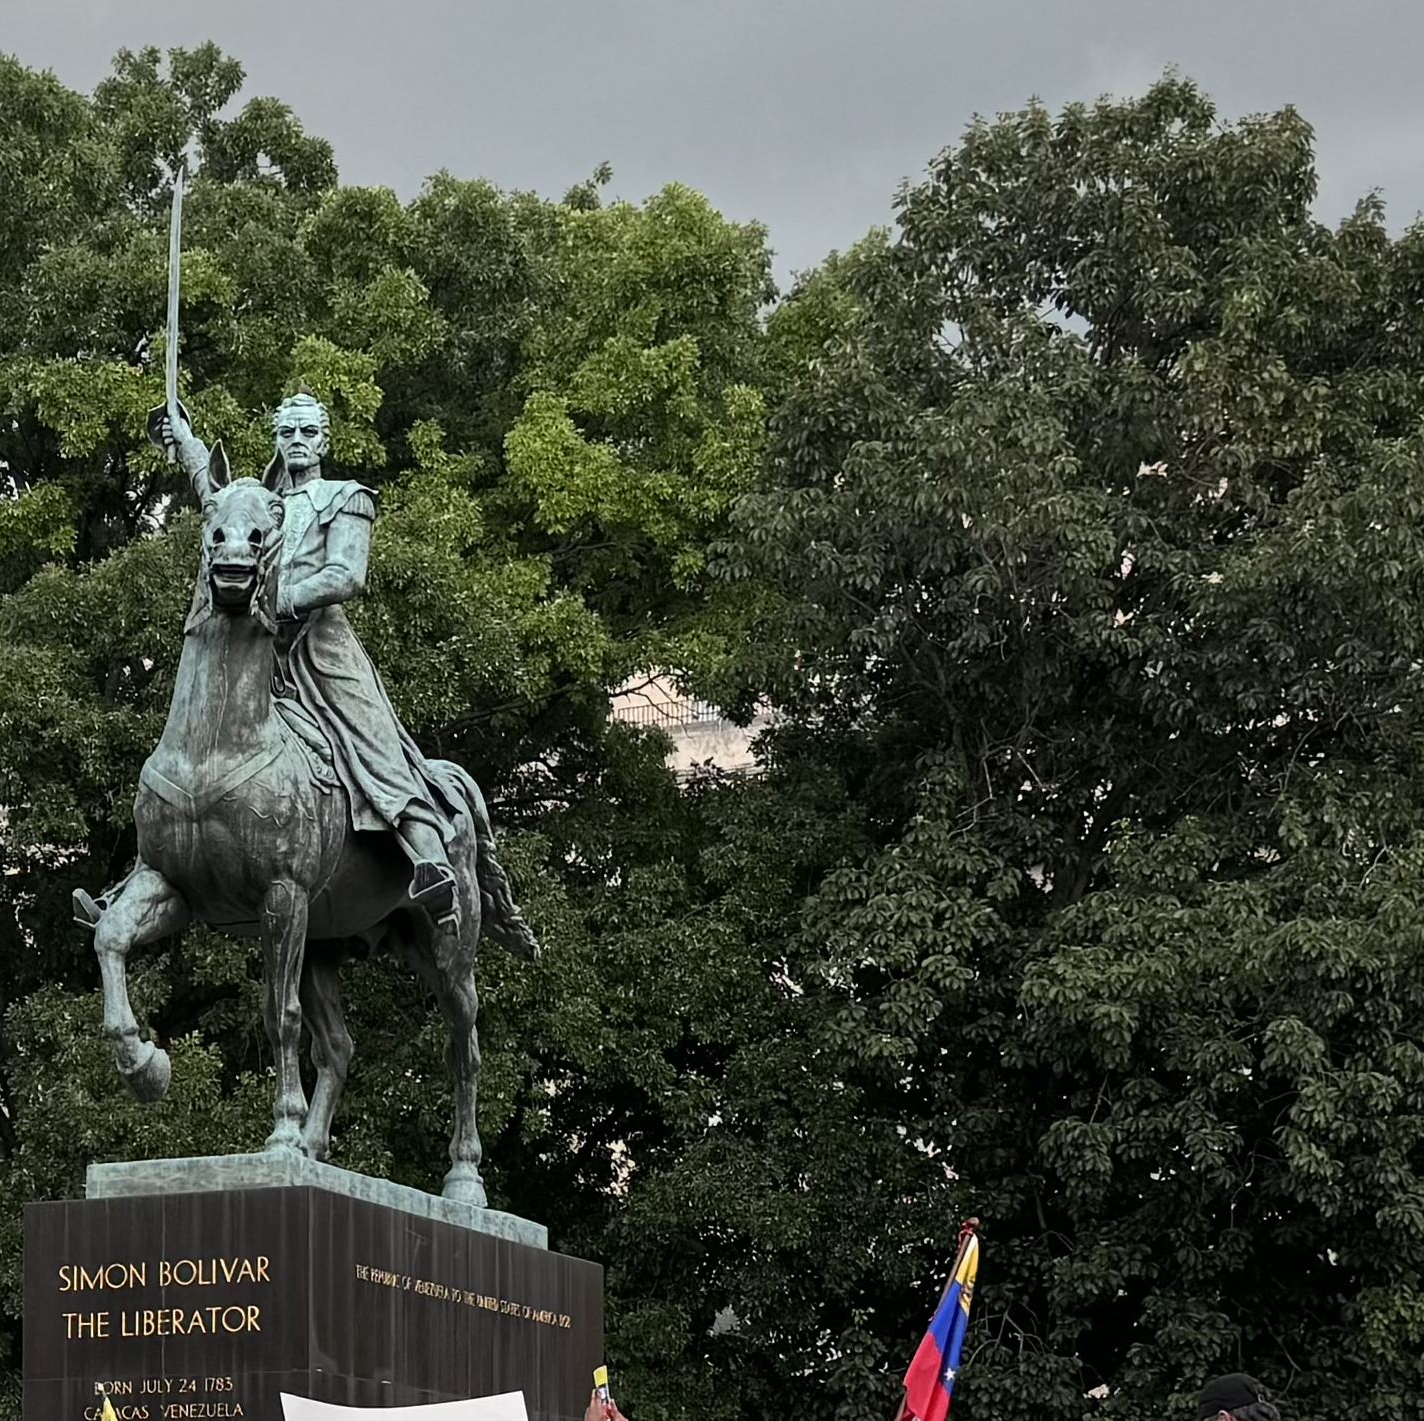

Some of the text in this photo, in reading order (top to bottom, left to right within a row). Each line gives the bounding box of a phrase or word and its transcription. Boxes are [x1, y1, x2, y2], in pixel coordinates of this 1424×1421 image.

[58, 1255, 271, 1292] SIMON BOLIVAR
[62, 1304, 262, 1339] THE LIBERATOR
[140, 1378, 173, 1394] JULY
[178, 1377, 197, 1393] 24
[204, 1376, 234, 1392] 1783
[160, 1402, 244, 1420] VENEZUELA
